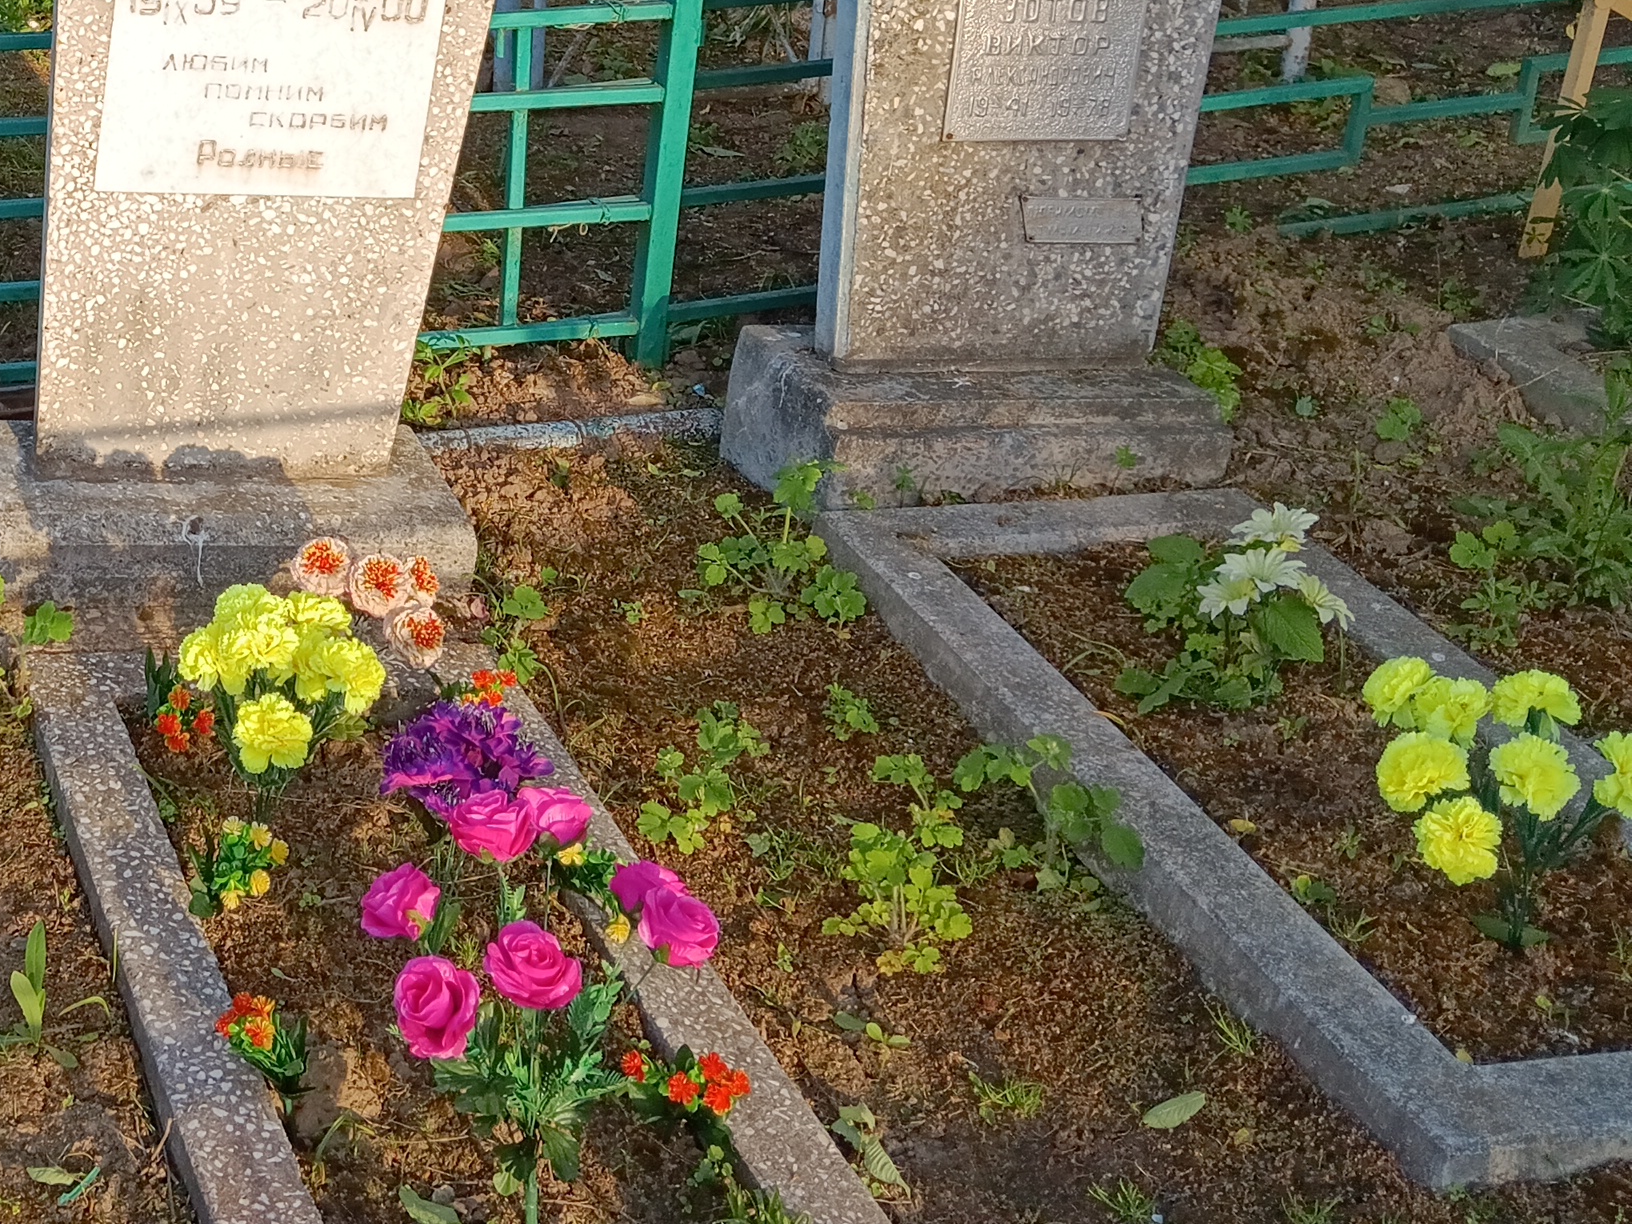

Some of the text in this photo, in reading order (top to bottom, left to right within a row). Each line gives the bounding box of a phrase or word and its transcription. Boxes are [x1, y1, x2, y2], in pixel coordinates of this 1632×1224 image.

[983, 31, 1112, 57] ВИКТОР
[204, 82, 325, 103] ПОМНИМ
[248, 110, 388, 133] СКОРБИМ
